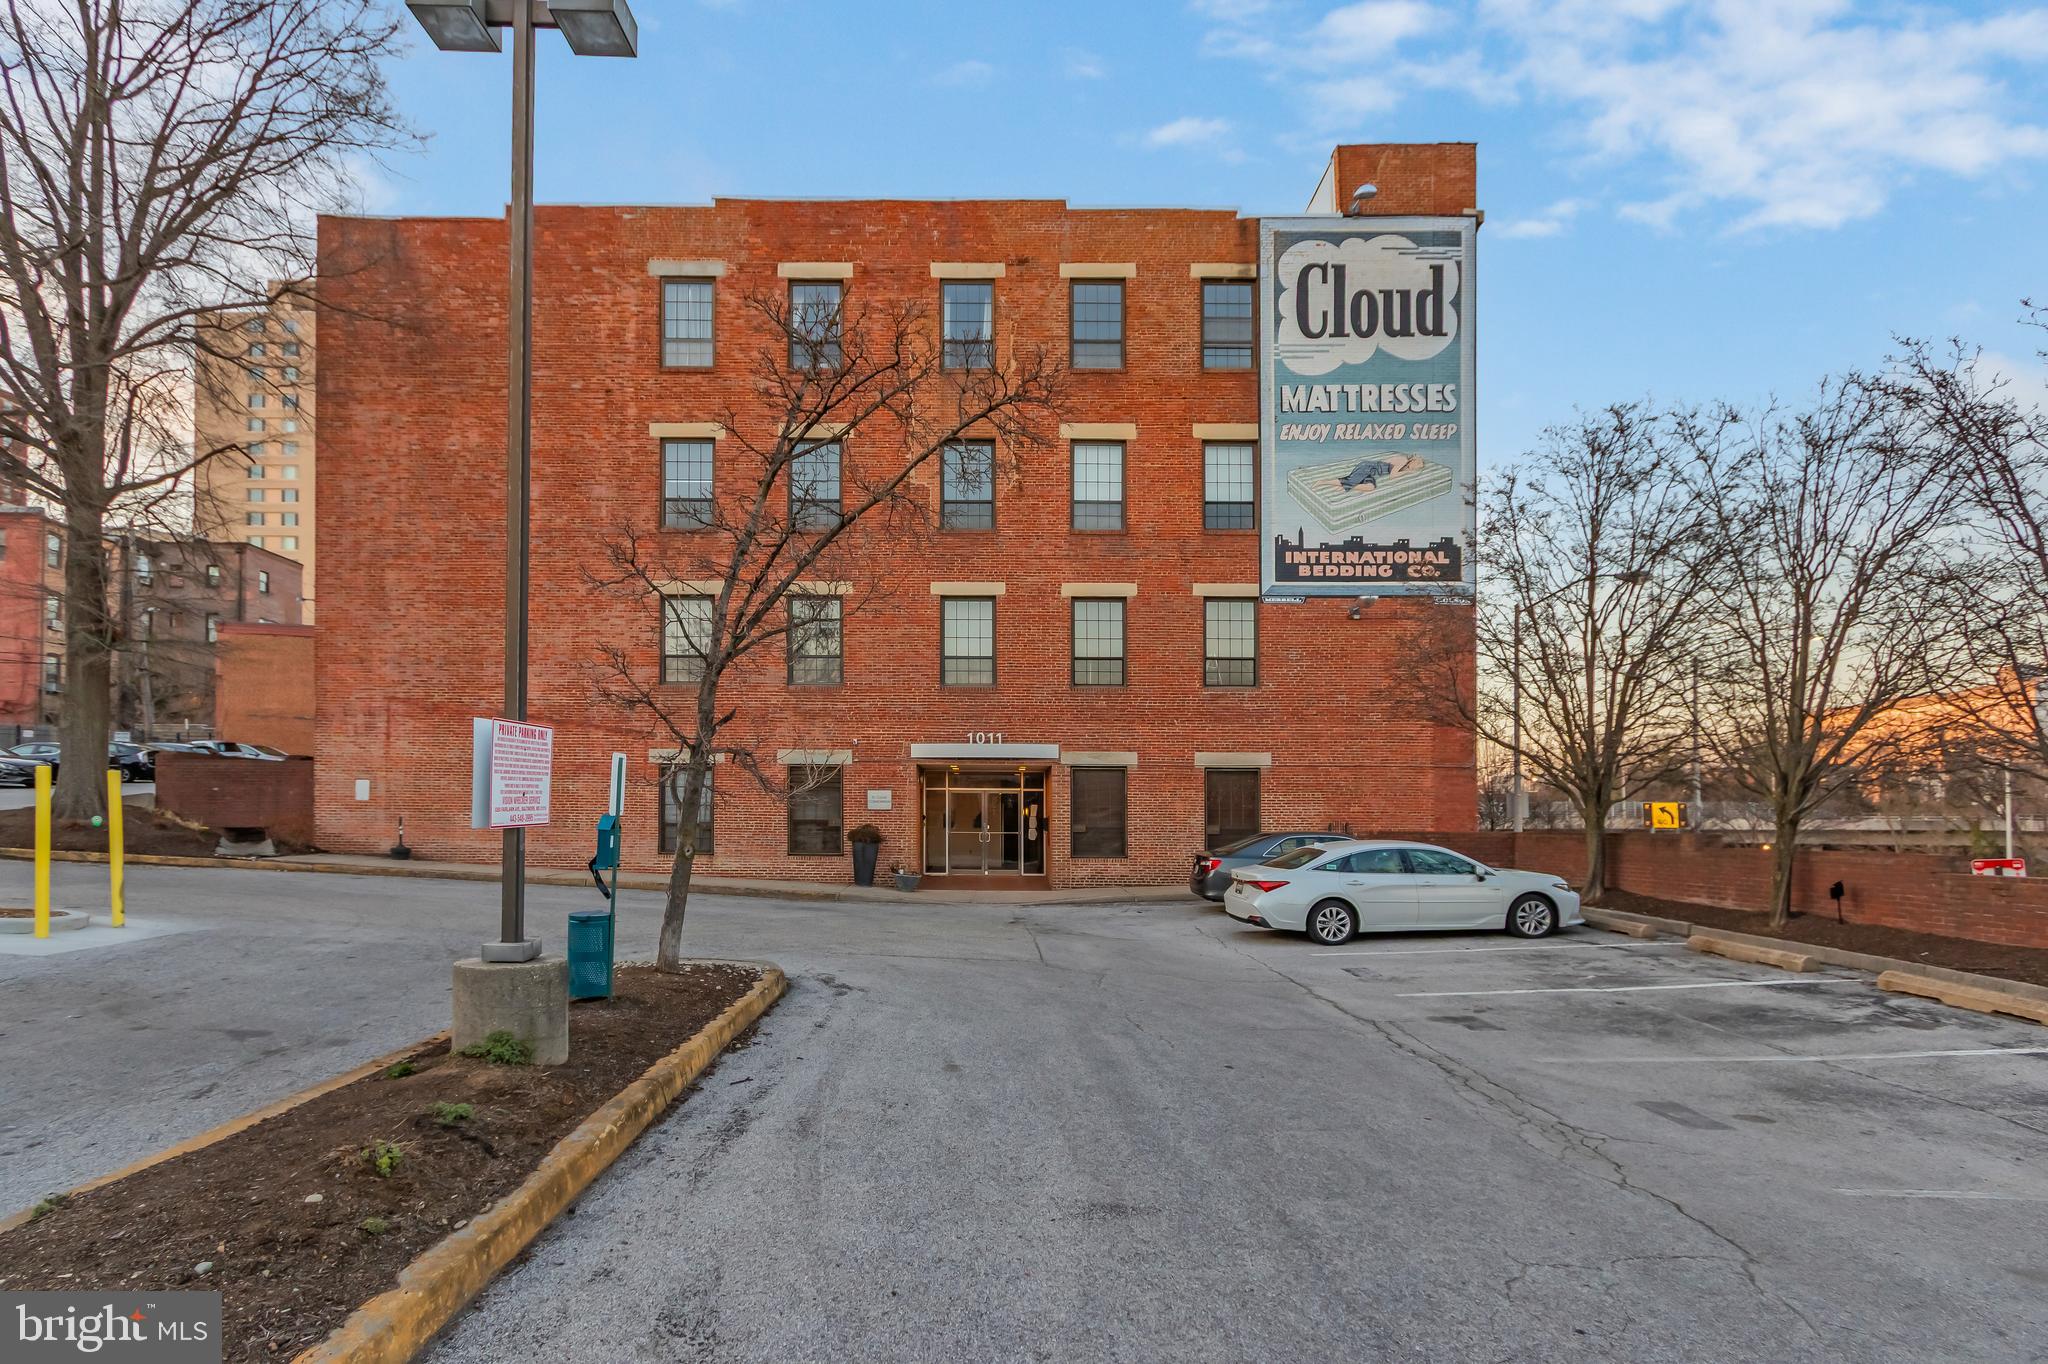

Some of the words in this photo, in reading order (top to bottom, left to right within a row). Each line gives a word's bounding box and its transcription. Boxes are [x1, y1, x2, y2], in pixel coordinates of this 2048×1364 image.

[1296, 261, 1448, 339] Cloud
[1280, 383, 1458, 413] MATTRESSES
[1280, 423, 1331, 443] ENJOY
[1333, 423, 1406, 441] RELAXED
[1409, 423, 1458, 441] SLEEP
[1285, 551, 1450, 564] INTERNATIONAL
[1298, 565, 1393, 578] BEDDING
[1407, 565, 1441, 578] CO.
[498, 723, 517, 737] PRIVATE
[519, 727, 537, 740] PARKING
[538, 730, 548, 741] ONLY
[967, 733, 1003, 744] 1011
